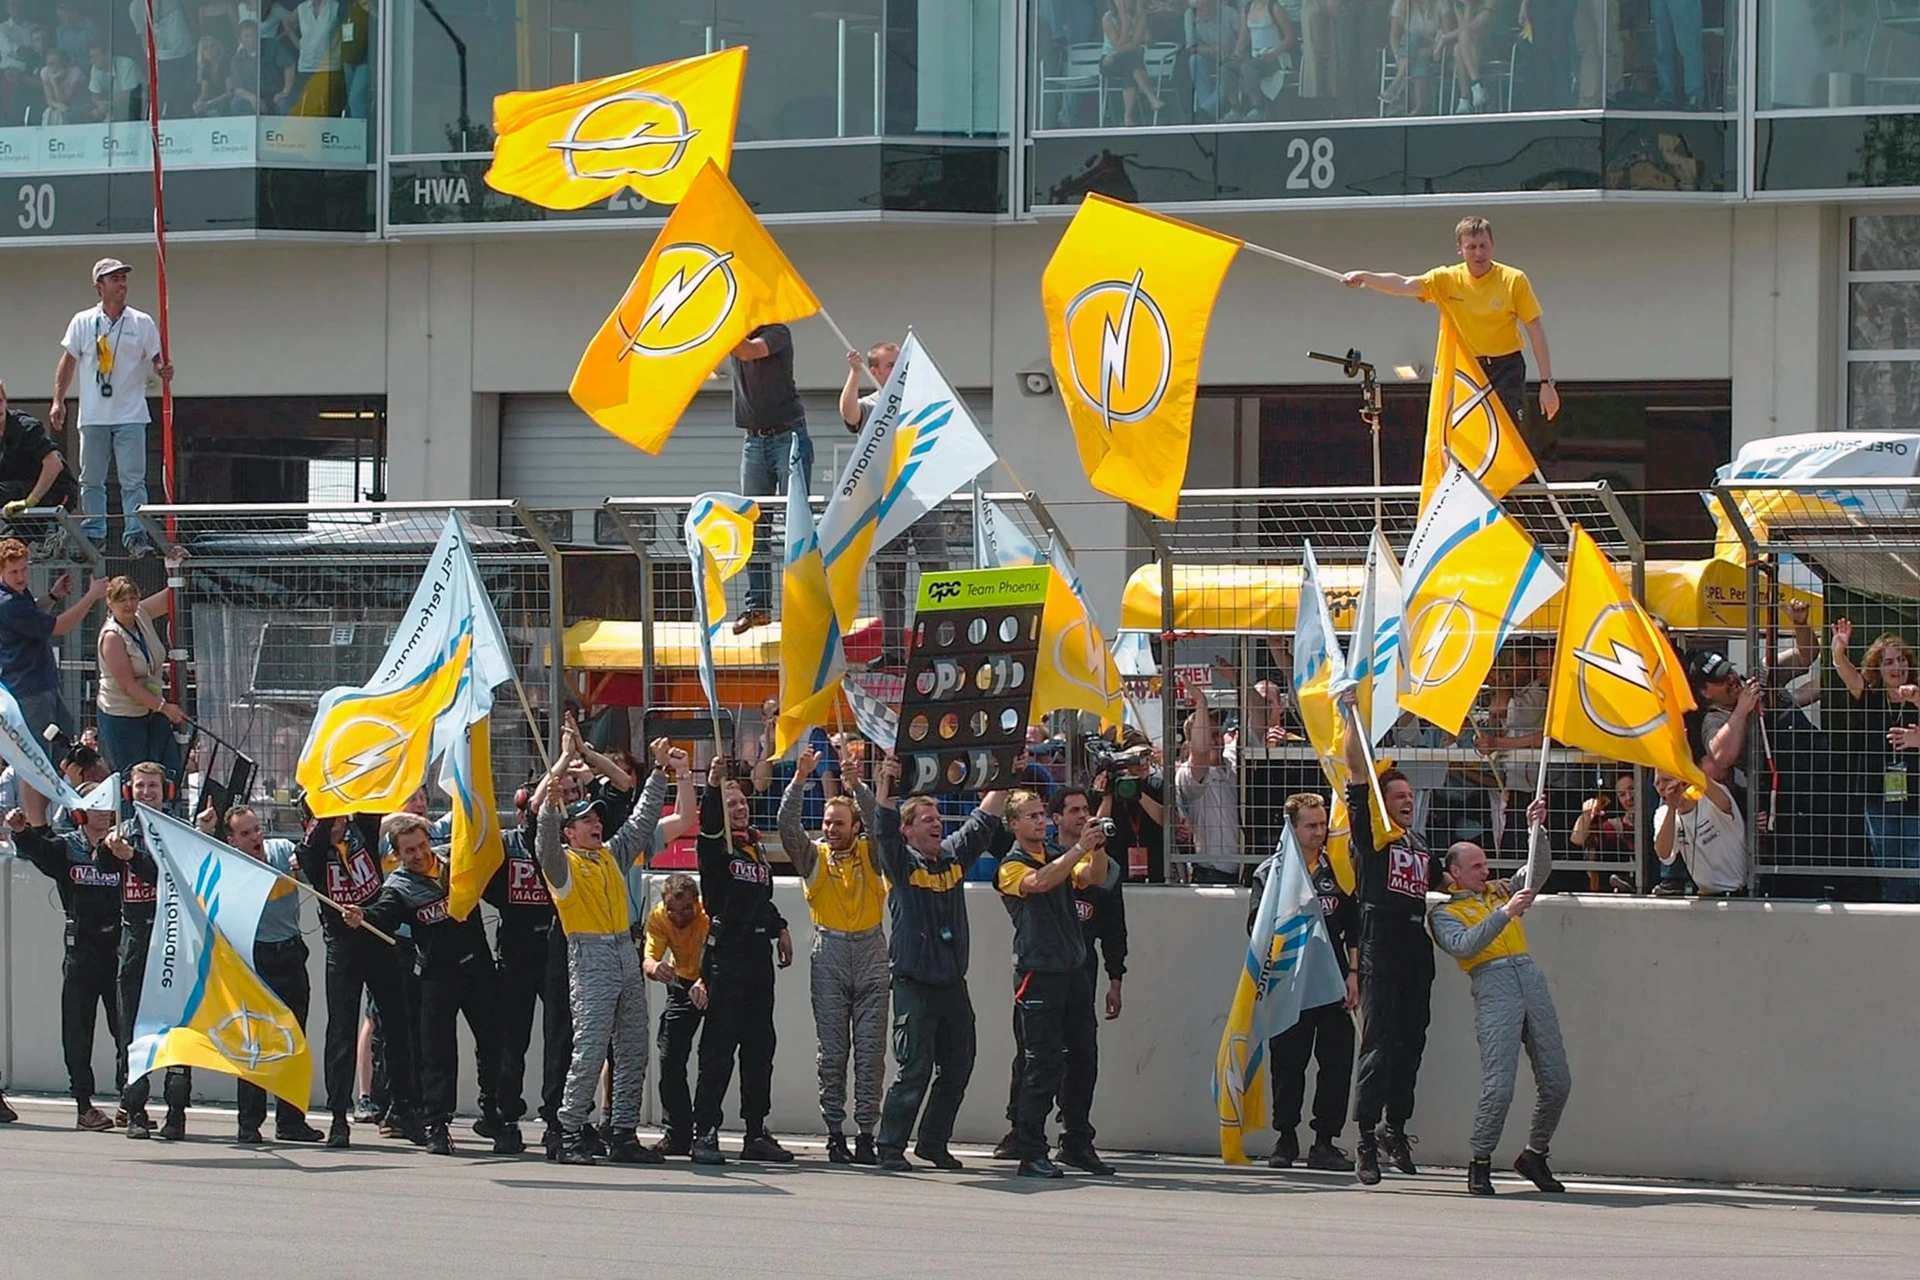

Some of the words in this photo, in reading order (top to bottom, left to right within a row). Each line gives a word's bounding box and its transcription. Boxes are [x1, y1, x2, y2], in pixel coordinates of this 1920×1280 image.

[211, 131, 228, 145] En
[266, 130, 284, 142] En
[321, 132, 340, 144] En
[49, 138, 65, 152] En
[1286, 136, 1335, 190] 28
[413, 178, 471, 205] HWA
[18, 183, 55, 230] 30
[967, 583, 995, 596] Team
[998, 580, 1041, 593] Phoenix
